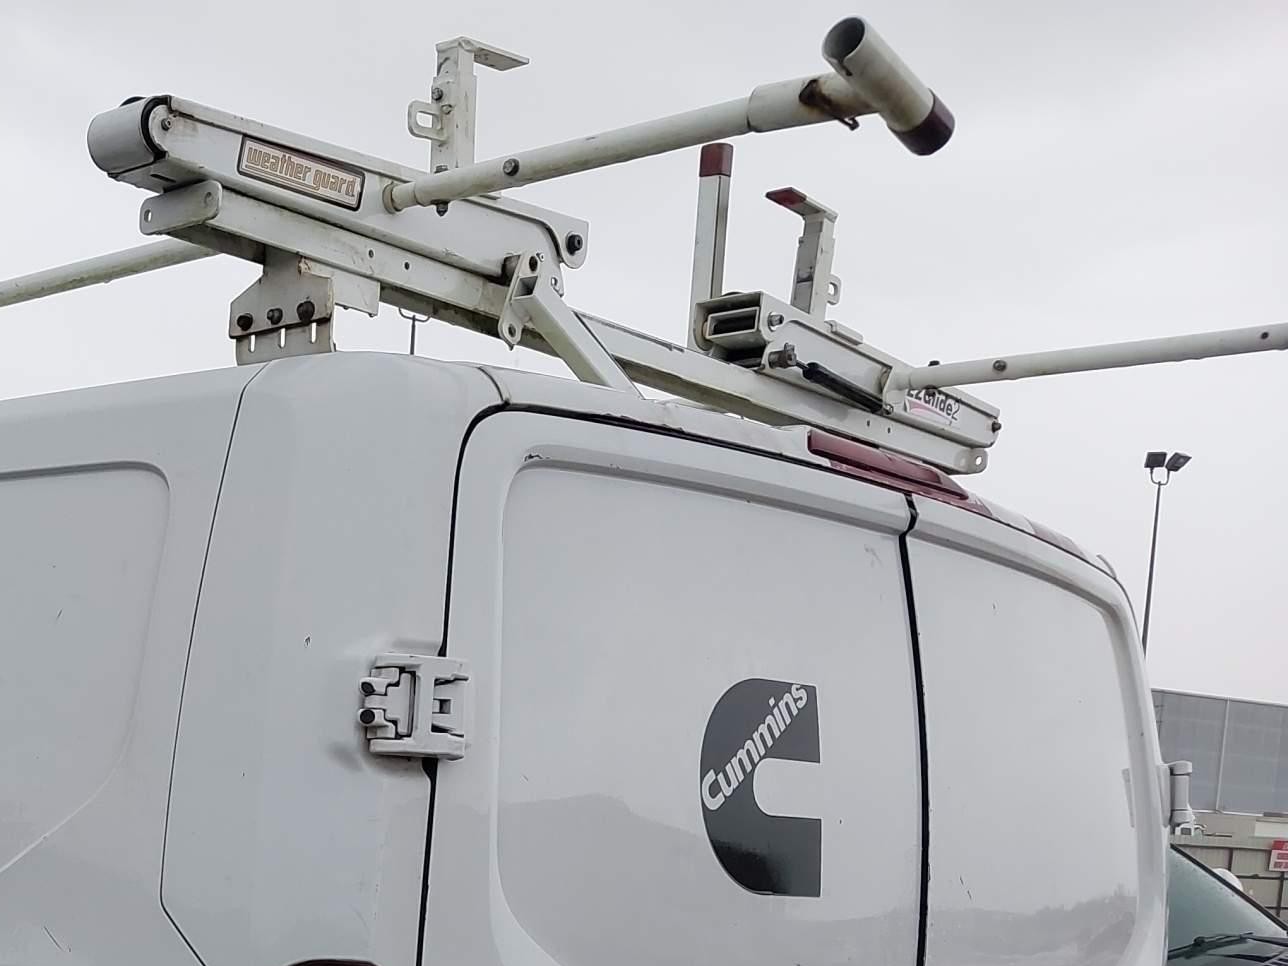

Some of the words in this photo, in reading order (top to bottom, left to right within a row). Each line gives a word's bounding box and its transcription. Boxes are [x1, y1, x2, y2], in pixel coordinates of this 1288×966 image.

[246, 146, 312, 182] weather
[312, 168, 356, 197] guard
[702, 684, 808, 811] Cummins
